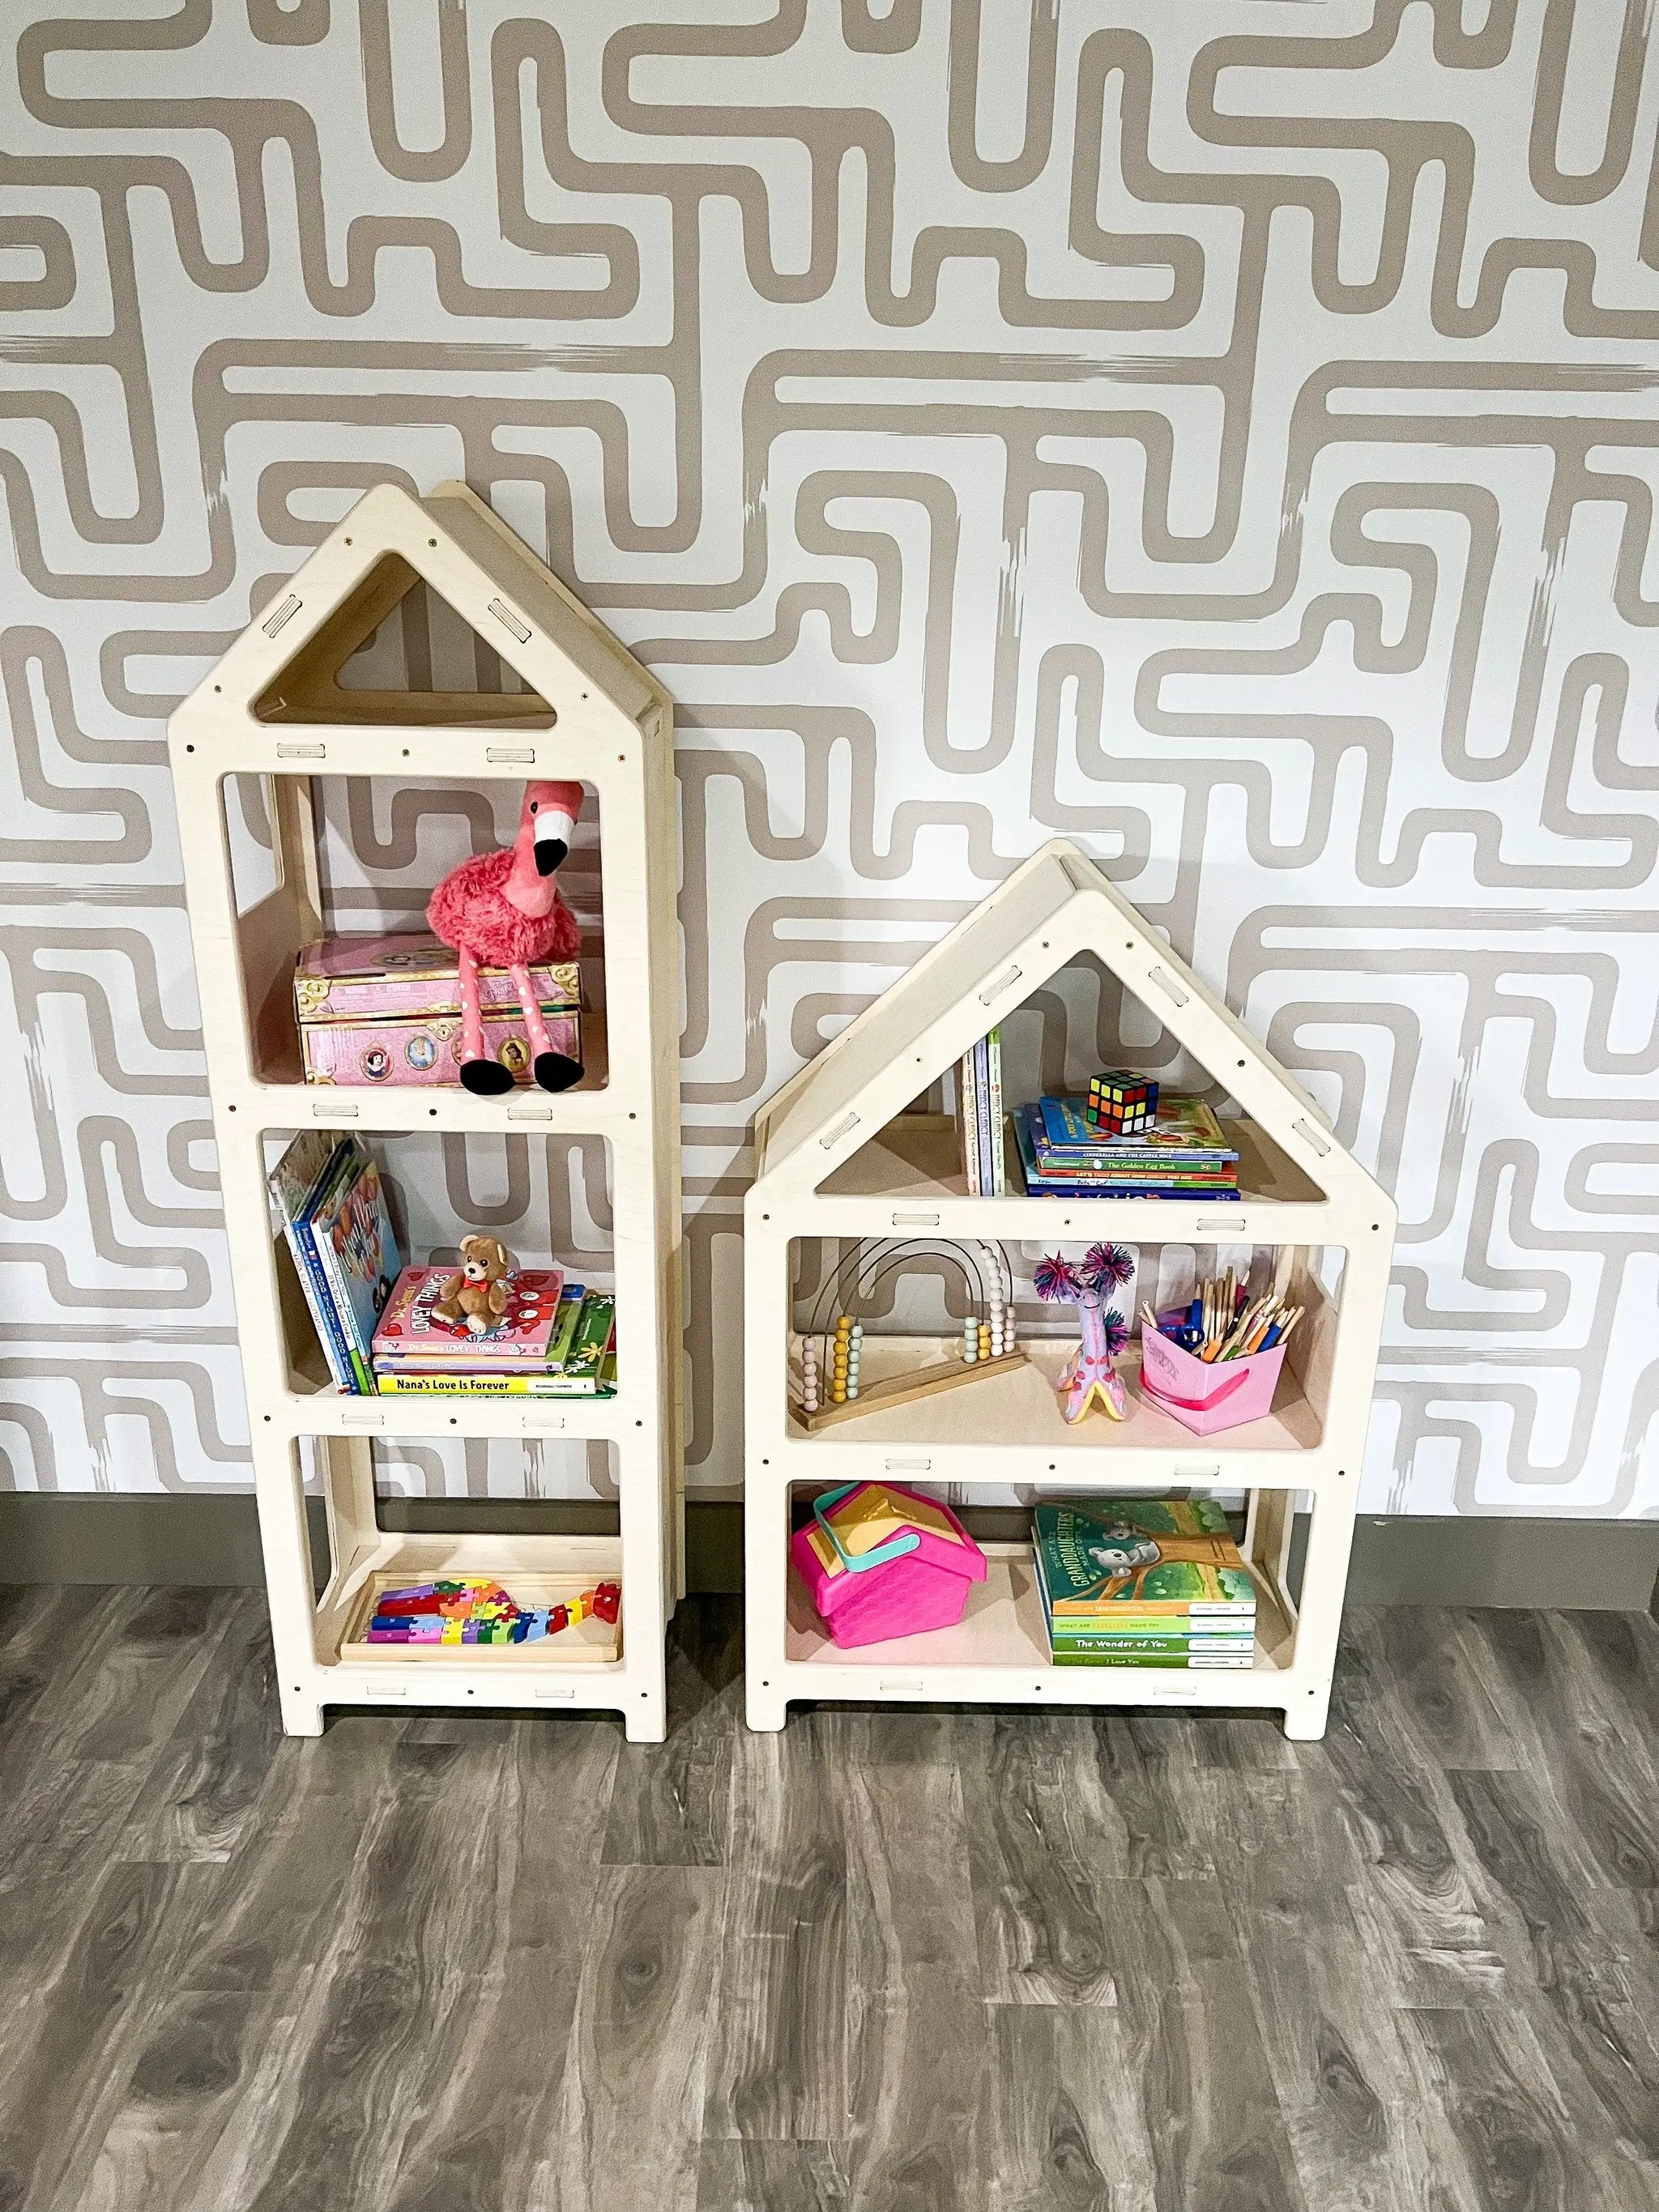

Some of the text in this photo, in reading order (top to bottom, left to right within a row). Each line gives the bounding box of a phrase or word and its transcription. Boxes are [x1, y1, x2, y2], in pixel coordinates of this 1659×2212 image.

[414, 1273, 450, 1302] THINGS
[314, 1269, 326, 1293] GOOD
[334, 1331, 345, 1354] GOOD
[342, 1356, 354, 1384] NIGHT
[411, 1305, 432, 1334] LOVEY
[475, 1345, 501, 1353] THINGS
[396, 1379, 510, 1390] Nana's Love Is Forever
[1048, 1546, 1062, 1569] WHAT
[1056, 1511, 1090, 1587] GRANDDAUGHTERS
[1076, 1545, 1090, 1566] MADE
[1076, 1639, 1167, 1648] The Wonder of You
